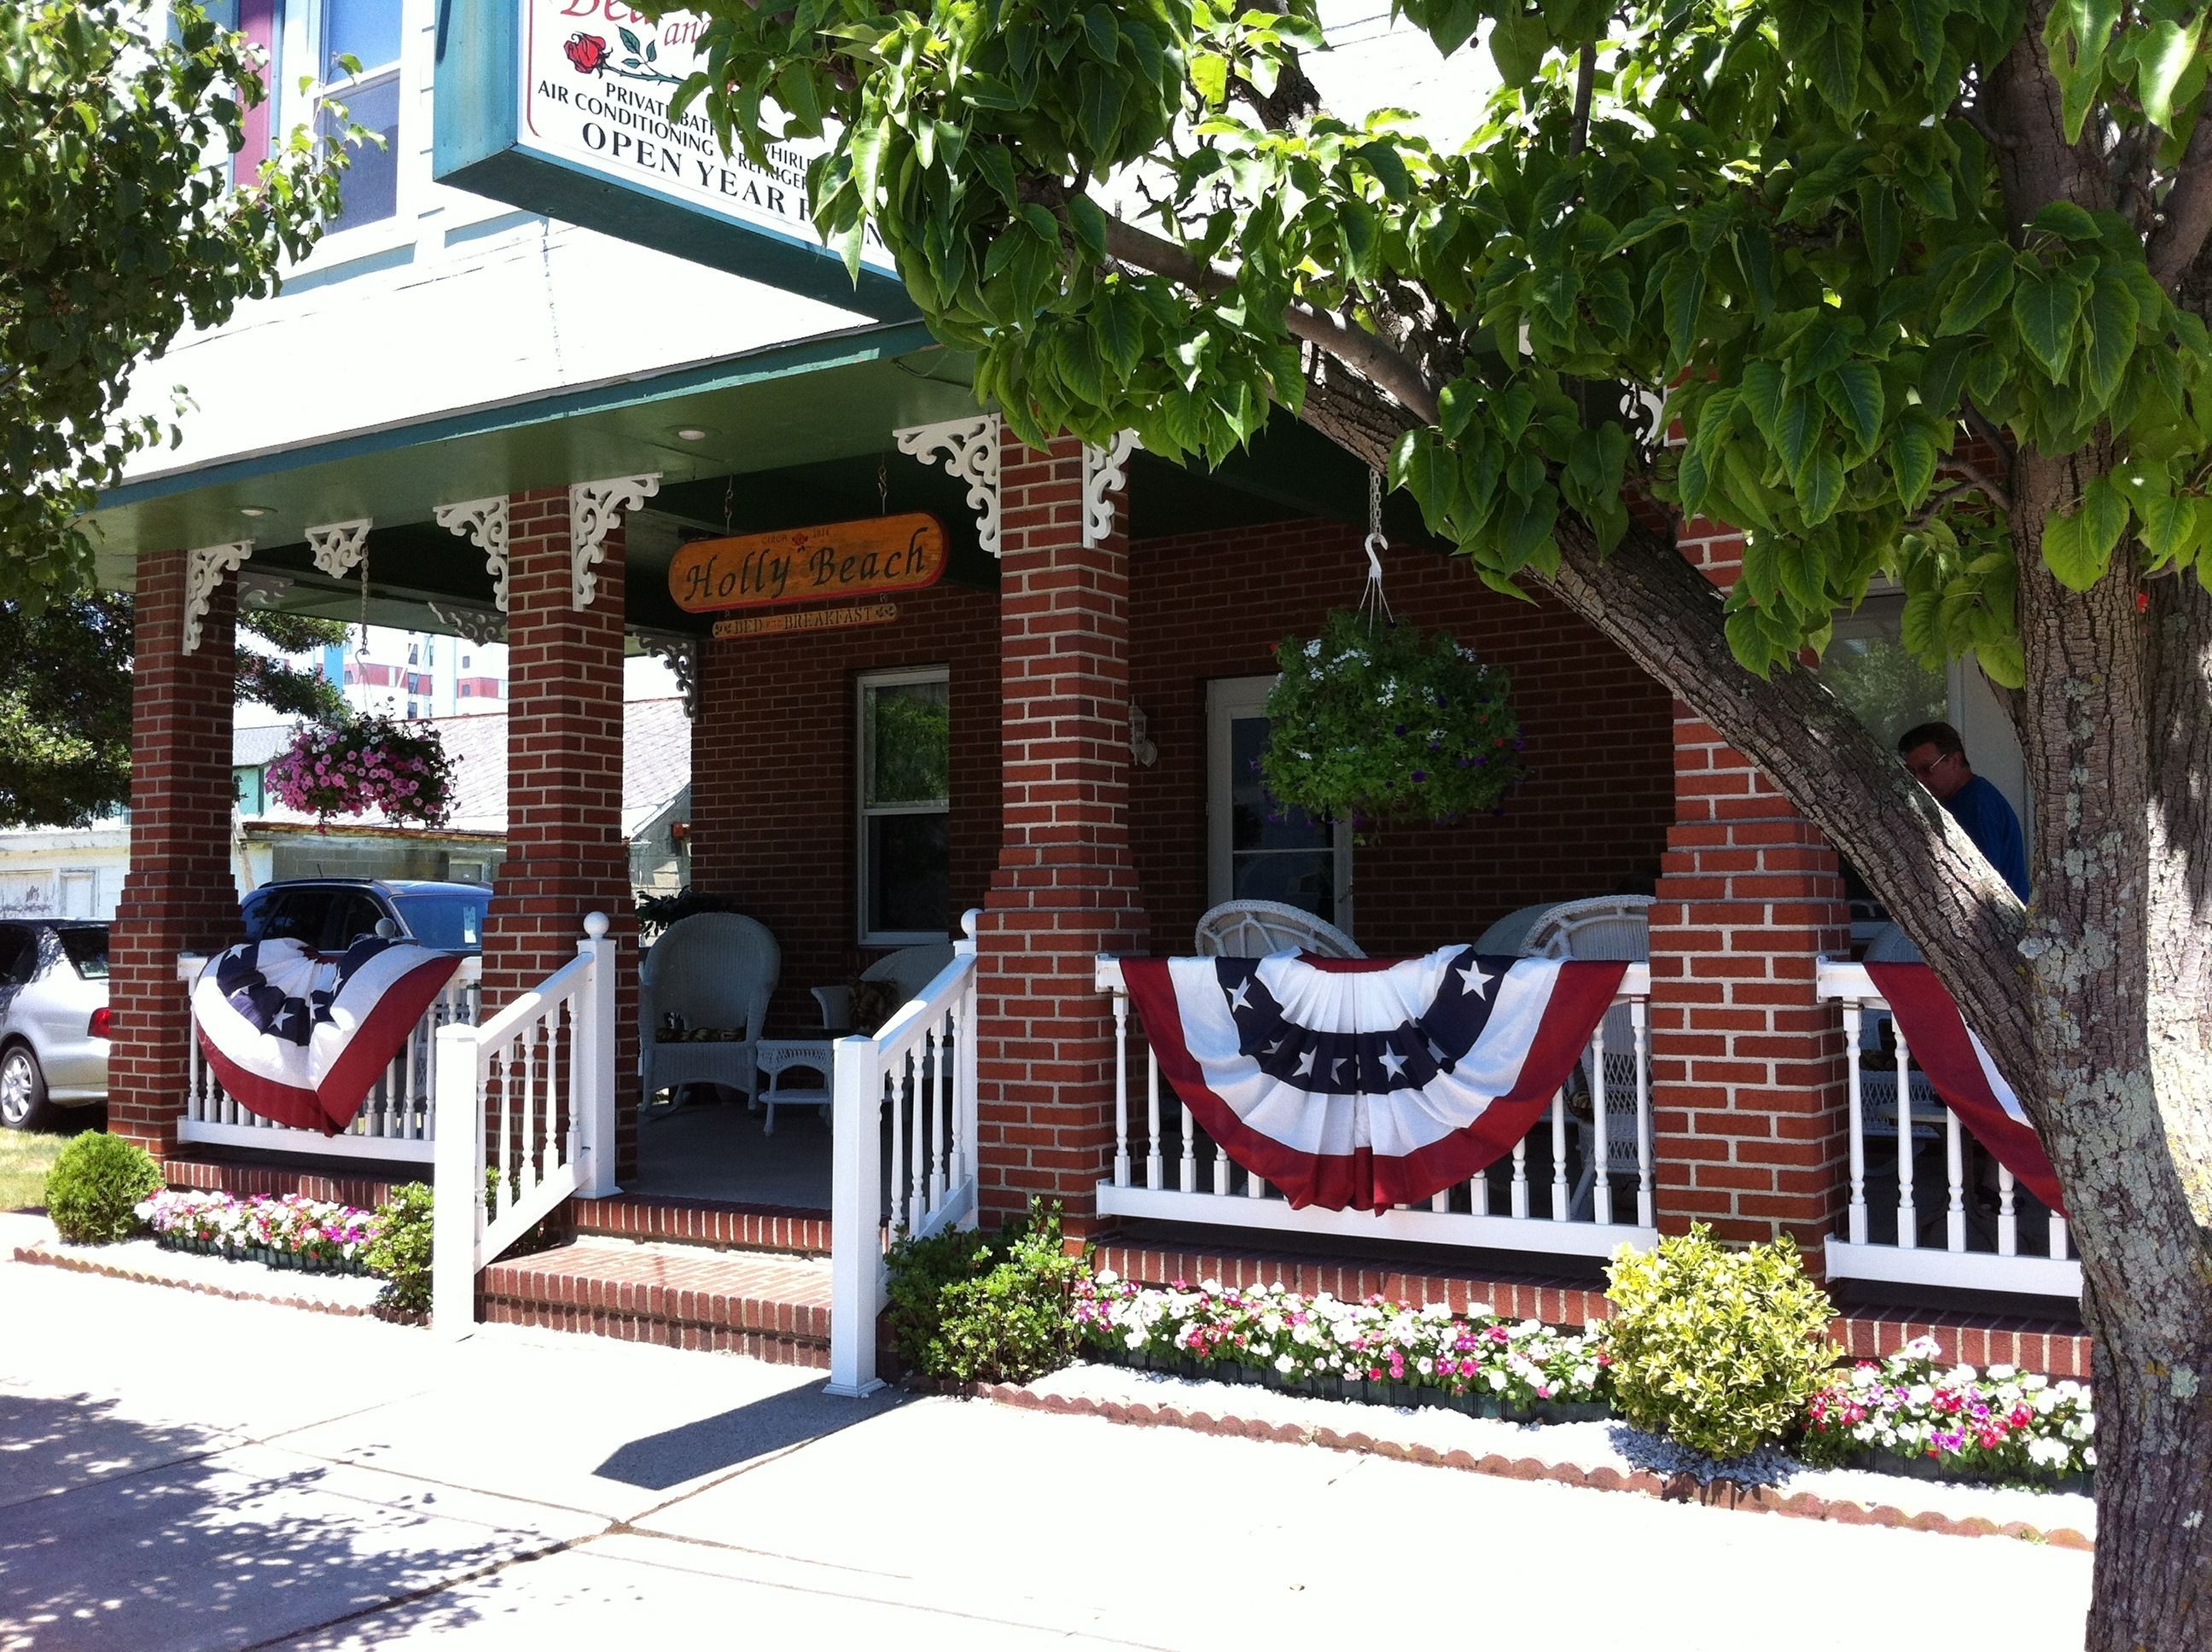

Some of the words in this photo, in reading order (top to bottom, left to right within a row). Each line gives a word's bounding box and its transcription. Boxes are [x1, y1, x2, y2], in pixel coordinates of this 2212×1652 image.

[538, 79, 569, 105] AIR
[574, 92, 714, 157] CONDITIONING
[606, 81, 669, 119] PRIVAT
[582, 122, 682, 177] OPEN
[696, 159, 786, 215] YEAR
[684, 547, 793, 602] Holly
[810, 526, 928, 587] Beach
[735, 617, 763, 635] BED
[784, 606, 873, 631] BREAKFAST
